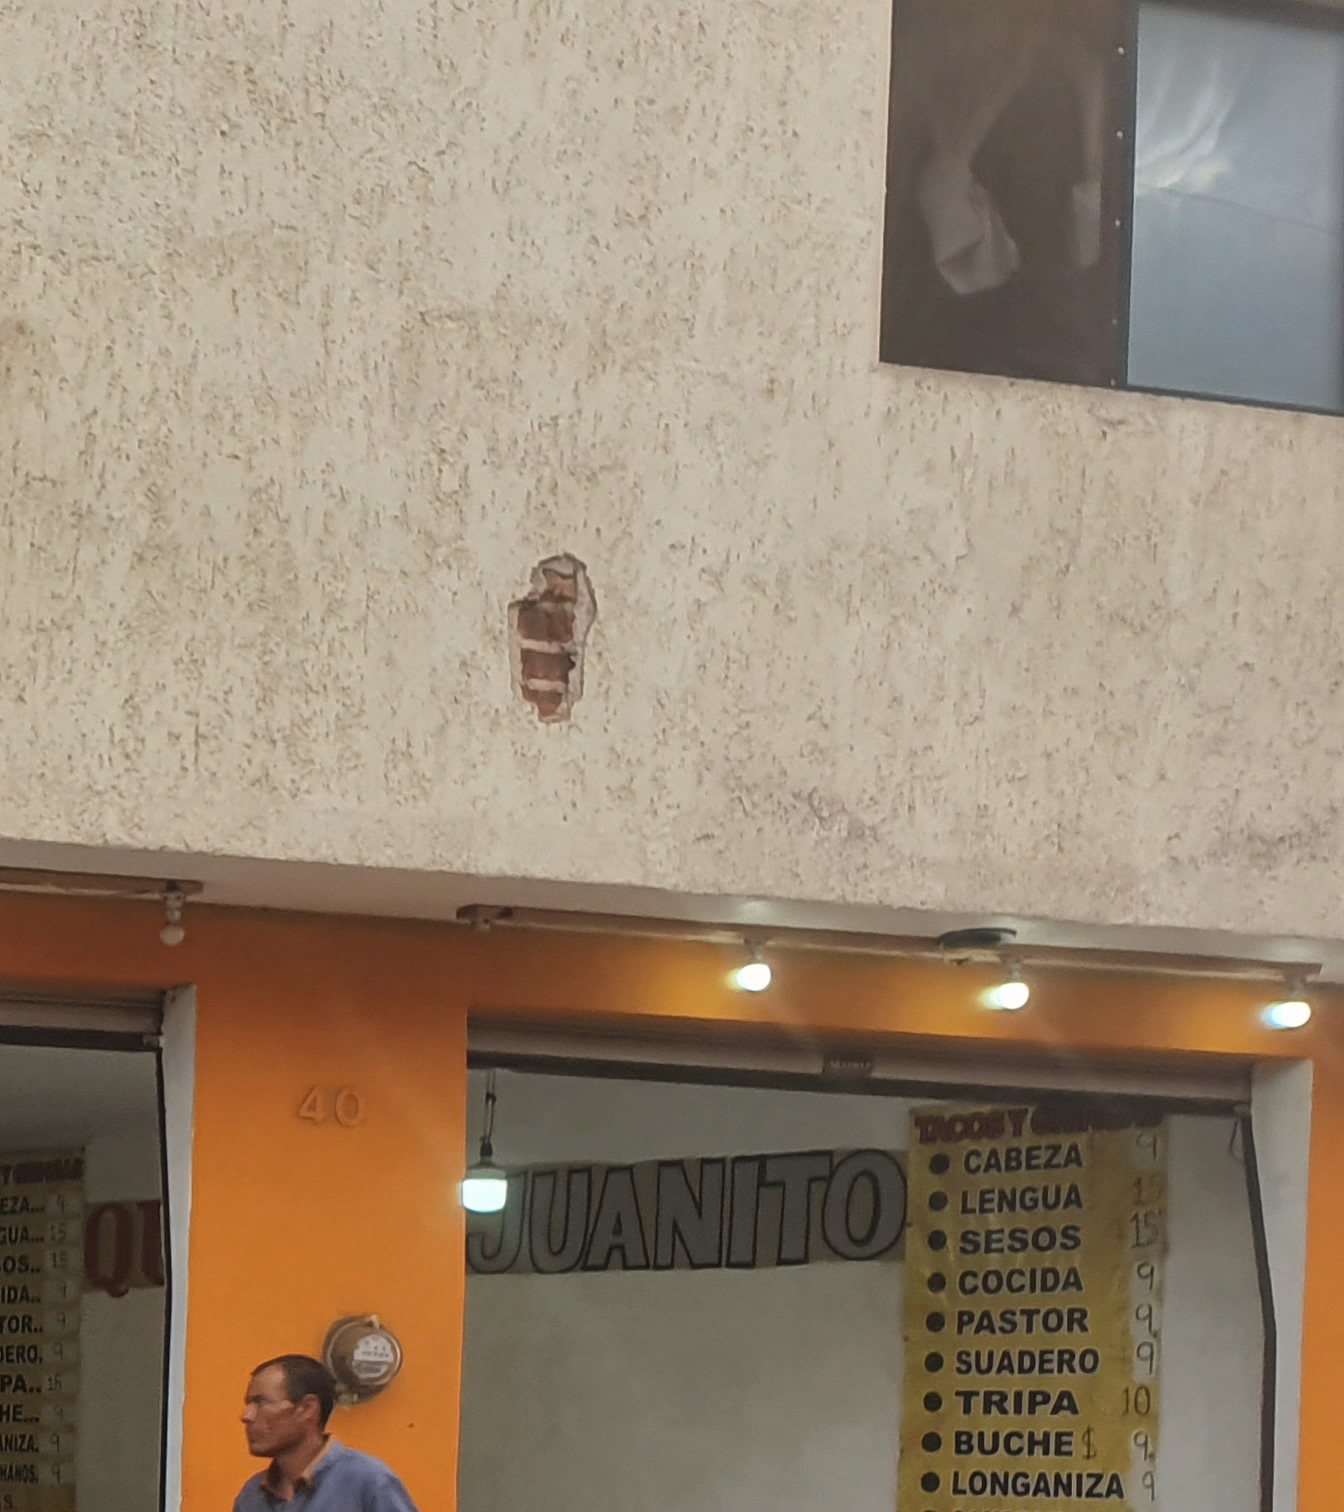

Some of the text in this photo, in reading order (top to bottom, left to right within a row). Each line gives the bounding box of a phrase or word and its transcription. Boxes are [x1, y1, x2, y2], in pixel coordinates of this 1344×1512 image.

[296, 1084, 365, 1128] 40
[1006, 1107, 1029, 1137] Y
[963, 1143, 1083, 1174] CABEZA
[466, 1149, 907, 1273] JUANITO
[960, 1184, 1083, 1214] LENGUA
[959, 1224, 1081, 1254] SESOS
[958, 1262, 1155, 1294] COCIDA 9
[956, 1307, 1089, 1335] PASTOR
[955, 1341, 1154, 1375] SUADERO 9
[955, 1385, 1151, 1415] TRIPA 10
[954, 1430, 1074, 1457] BUCHE
[1082, 1426, 1097, 1460] $
[953, 1471, 1155, 1501] LONGANIZA 9
